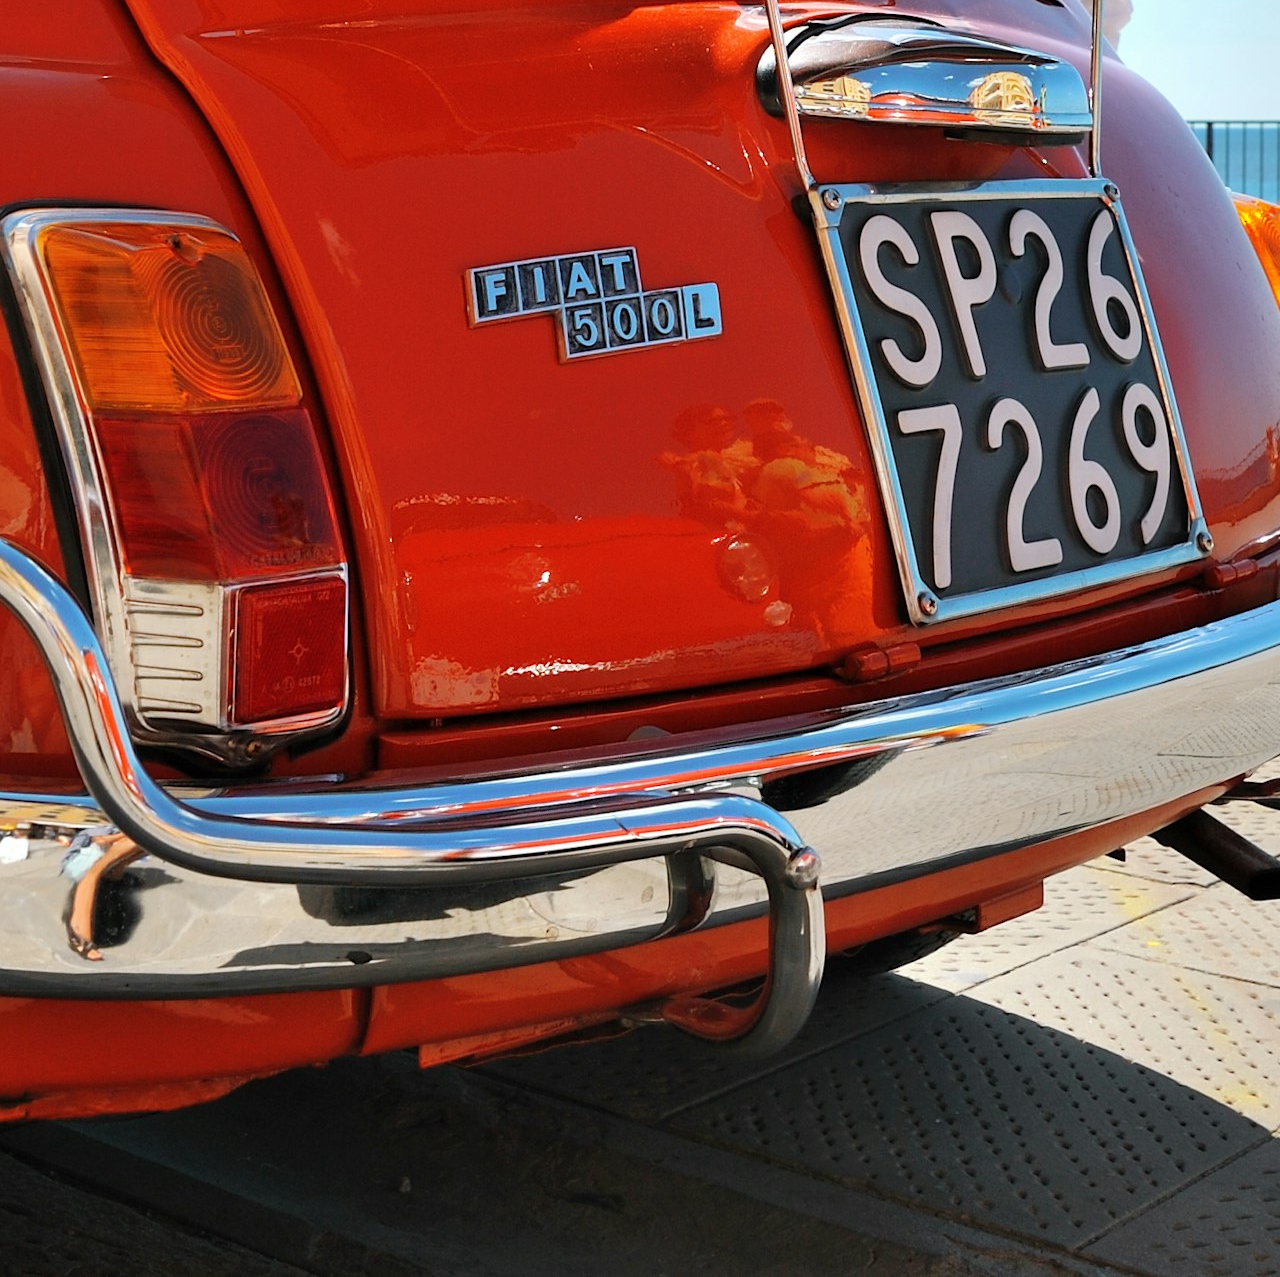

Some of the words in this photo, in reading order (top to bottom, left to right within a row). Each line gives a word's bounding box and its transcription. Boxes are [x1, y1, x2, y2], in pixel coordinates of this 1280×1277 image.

[484, 256, 630, 312] FIAT
[572, 284, 718, 353] 500L
[860, 208, 1143, 386] SP26
[898, 382, 1173, 589] 7269
